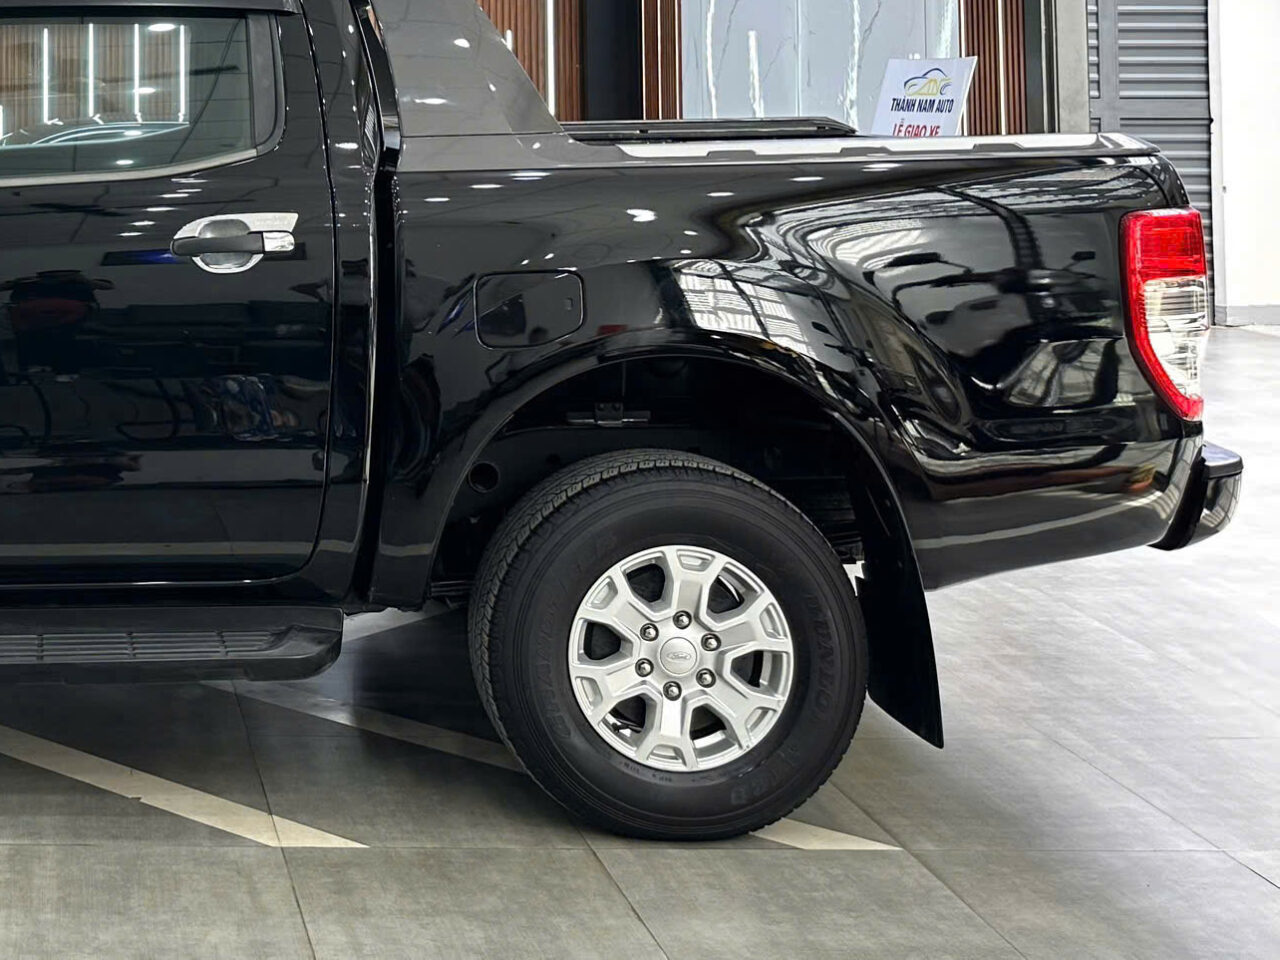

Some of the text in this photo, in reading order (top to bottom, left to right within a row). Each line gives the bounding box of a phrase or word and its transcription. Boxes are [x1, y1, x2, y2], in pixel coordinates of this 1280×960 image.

[891, 96, 954, 113] THÀNH NAM AUTO
